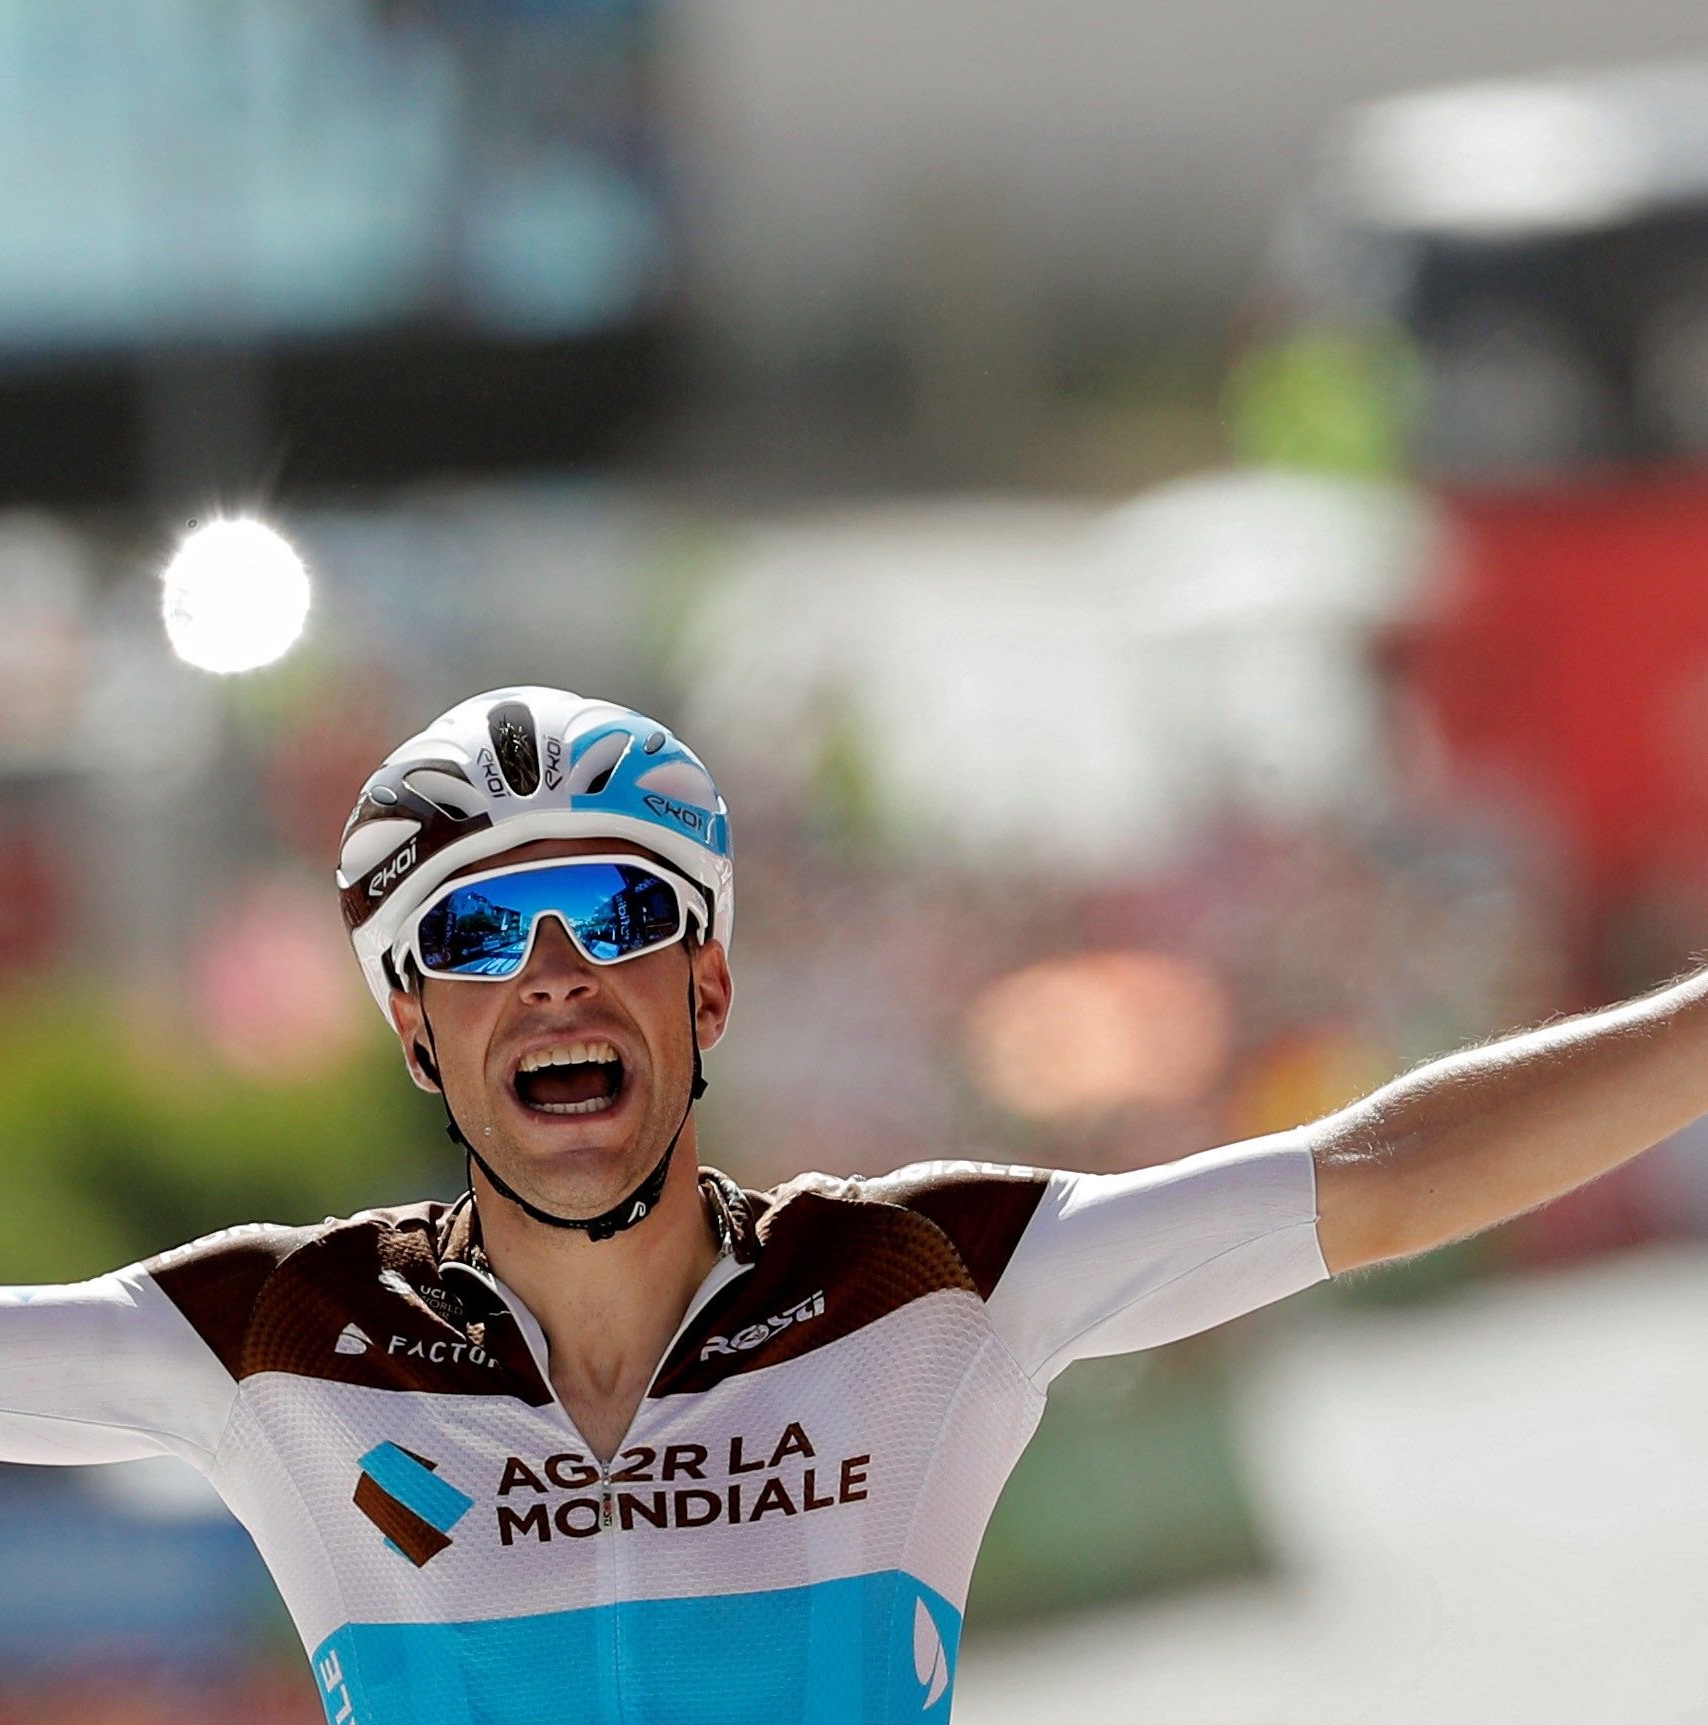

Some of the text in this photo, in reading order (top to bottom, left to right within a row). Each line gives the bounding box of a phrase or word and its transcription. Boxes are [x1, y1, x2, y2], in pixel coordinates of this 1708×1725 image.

[420, 1285, 446, 1300] UCI
[497, 1421, 815, 1496] AG2R LA
[497, 1454, 871, 1546] MONDIALE
